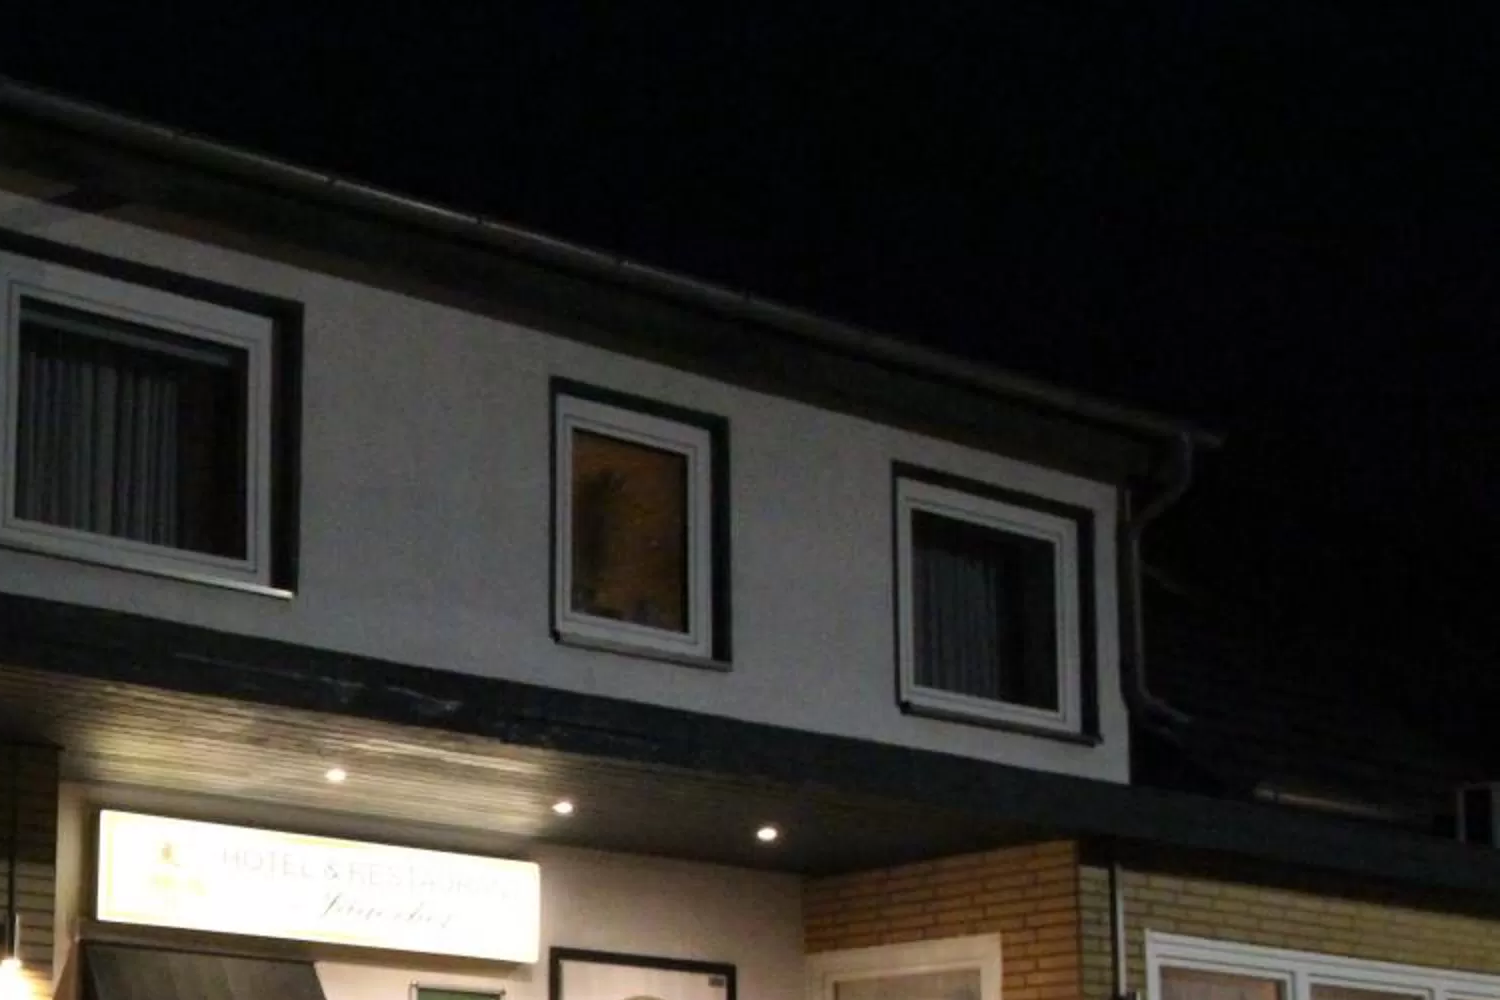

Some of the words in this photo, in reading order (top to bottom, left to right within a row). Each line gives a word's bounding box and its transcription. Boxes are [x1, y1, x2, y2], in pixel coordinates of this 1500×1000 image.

[221, 847, 315, 882] HOTEL
[323, 859, 341, 882] &
[346, 860, 519, 901] RESTAUR
